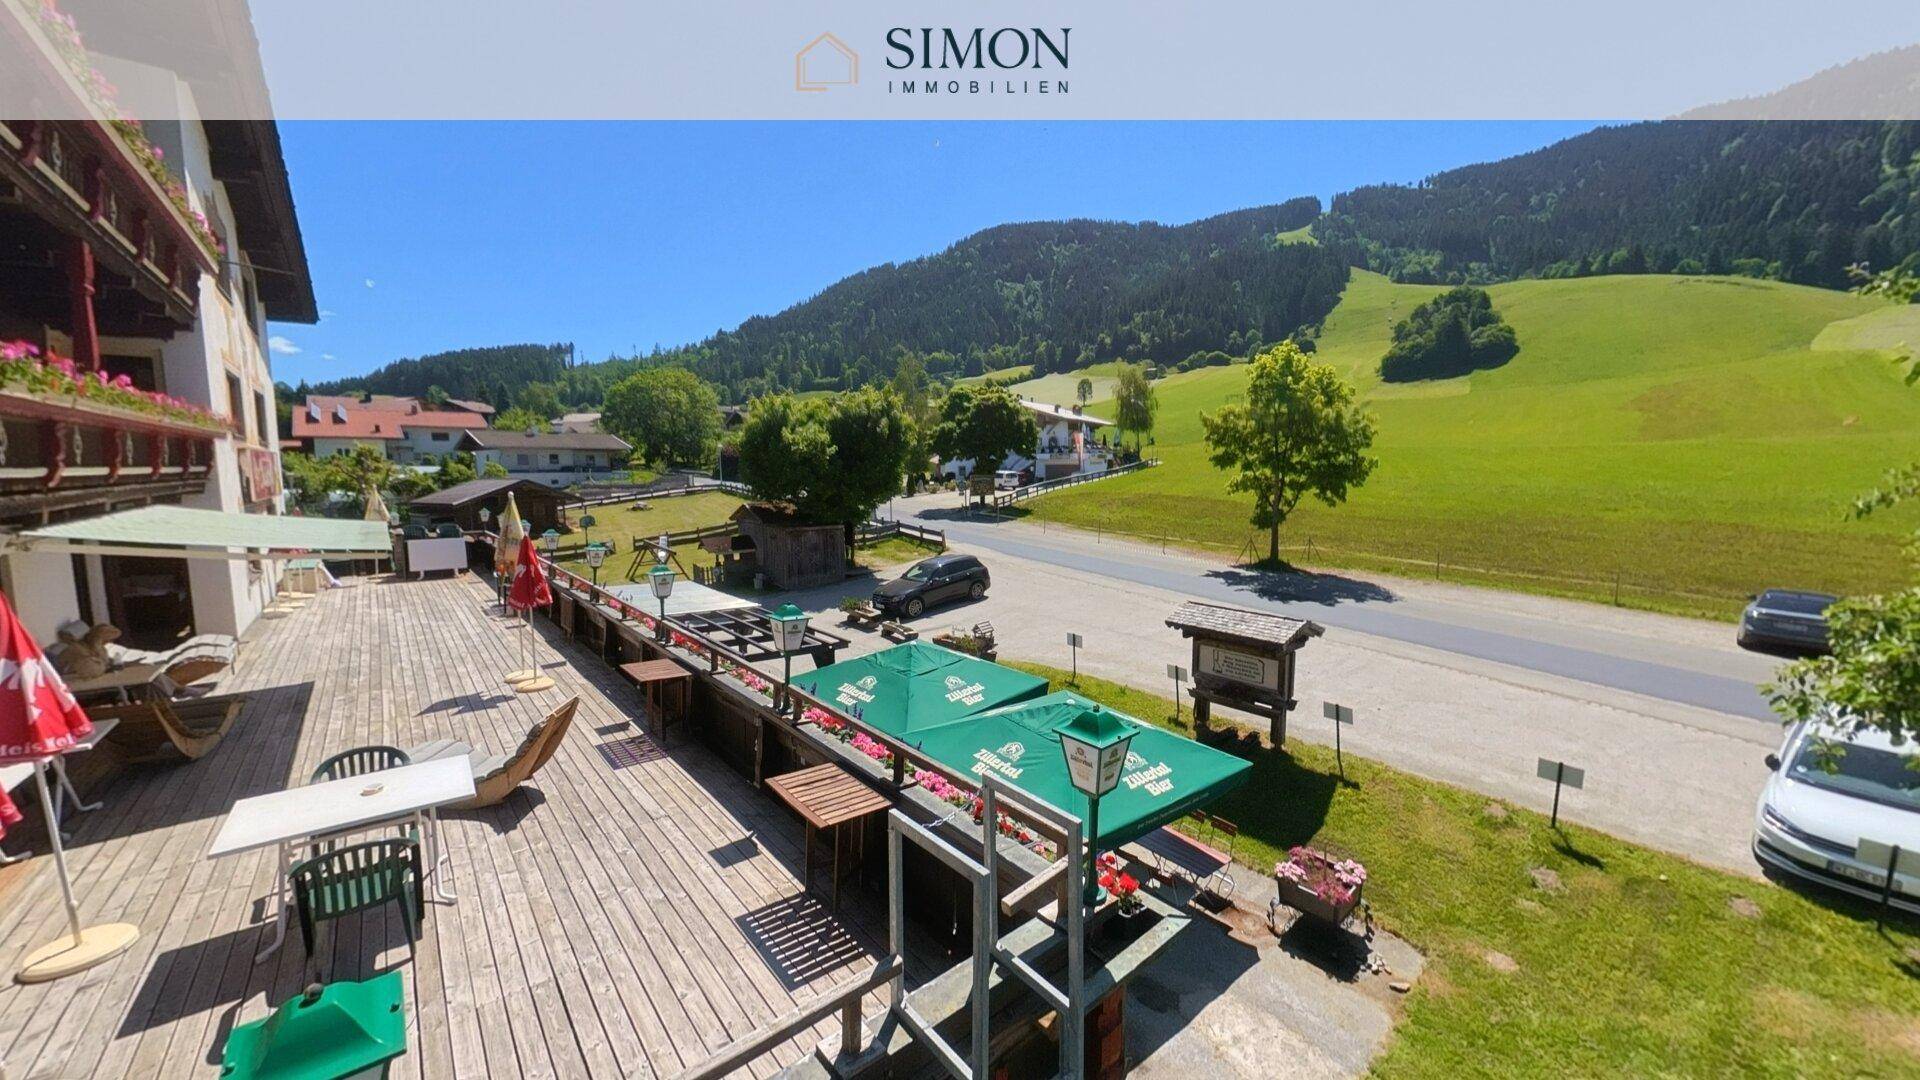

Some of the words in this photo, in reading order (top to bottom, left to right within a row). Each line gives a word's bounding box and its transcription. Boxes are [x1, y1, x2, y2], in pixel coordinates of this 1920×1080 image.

[836, 692, 858, 706] Bier
[838, 683, 876, 702] Zillertal
[945, 682, 985, 702] Zillertal
[961, 693, 985, 706] Bier
[972, 748, 1024, 779] Zillertal
[1121, 762, 1173, 789] Zillertal
[1144, 778, 1174, 796] Bier
